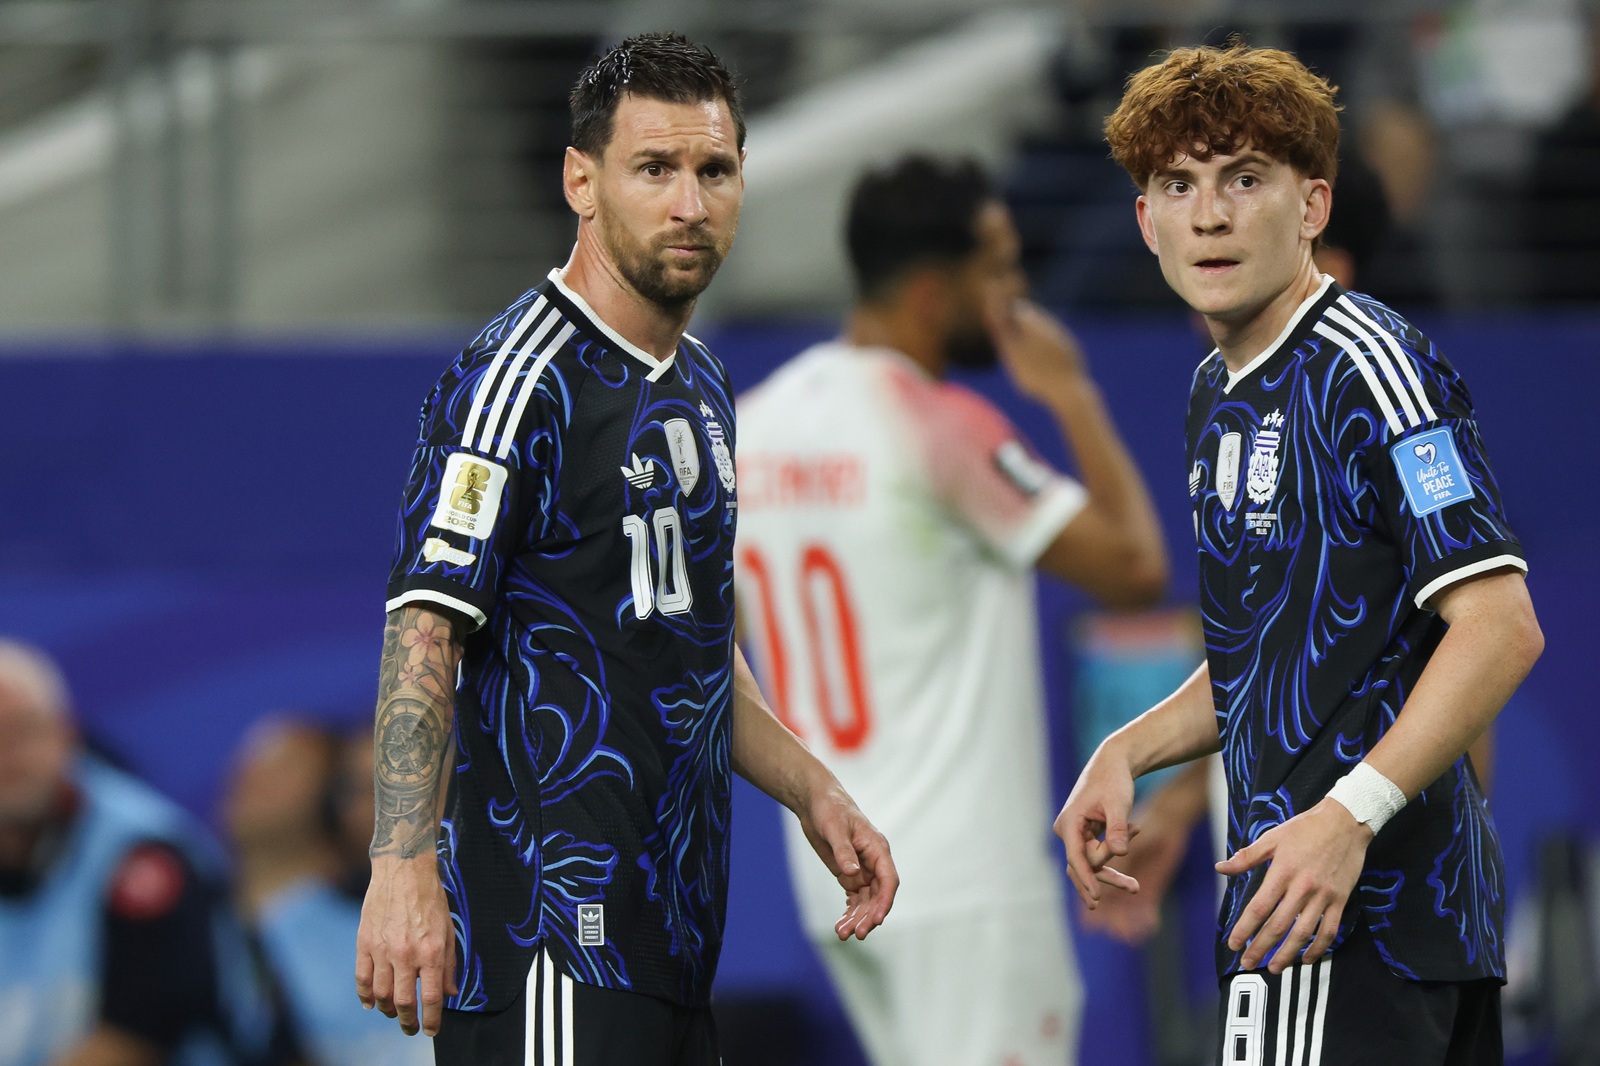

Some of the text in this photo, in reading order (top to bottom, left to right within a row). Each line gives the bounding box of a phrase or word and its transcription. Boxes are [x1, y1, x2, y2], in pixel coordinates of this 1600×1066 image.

[679, 466, 692, 476] FIFA
[1416, 461, 1450, 483] Unite For
[1422, 474, 1455, 495] PEACE
[457, 501, 473, 510] FIFA
[1433, 490, 1452, 501] FIFA
[444, 516, 475, 530] 2026
[622, 506, 694, 620] 10
[740, 541, 873, 755] 10
[1222, 974, 1268, 1066] 8
